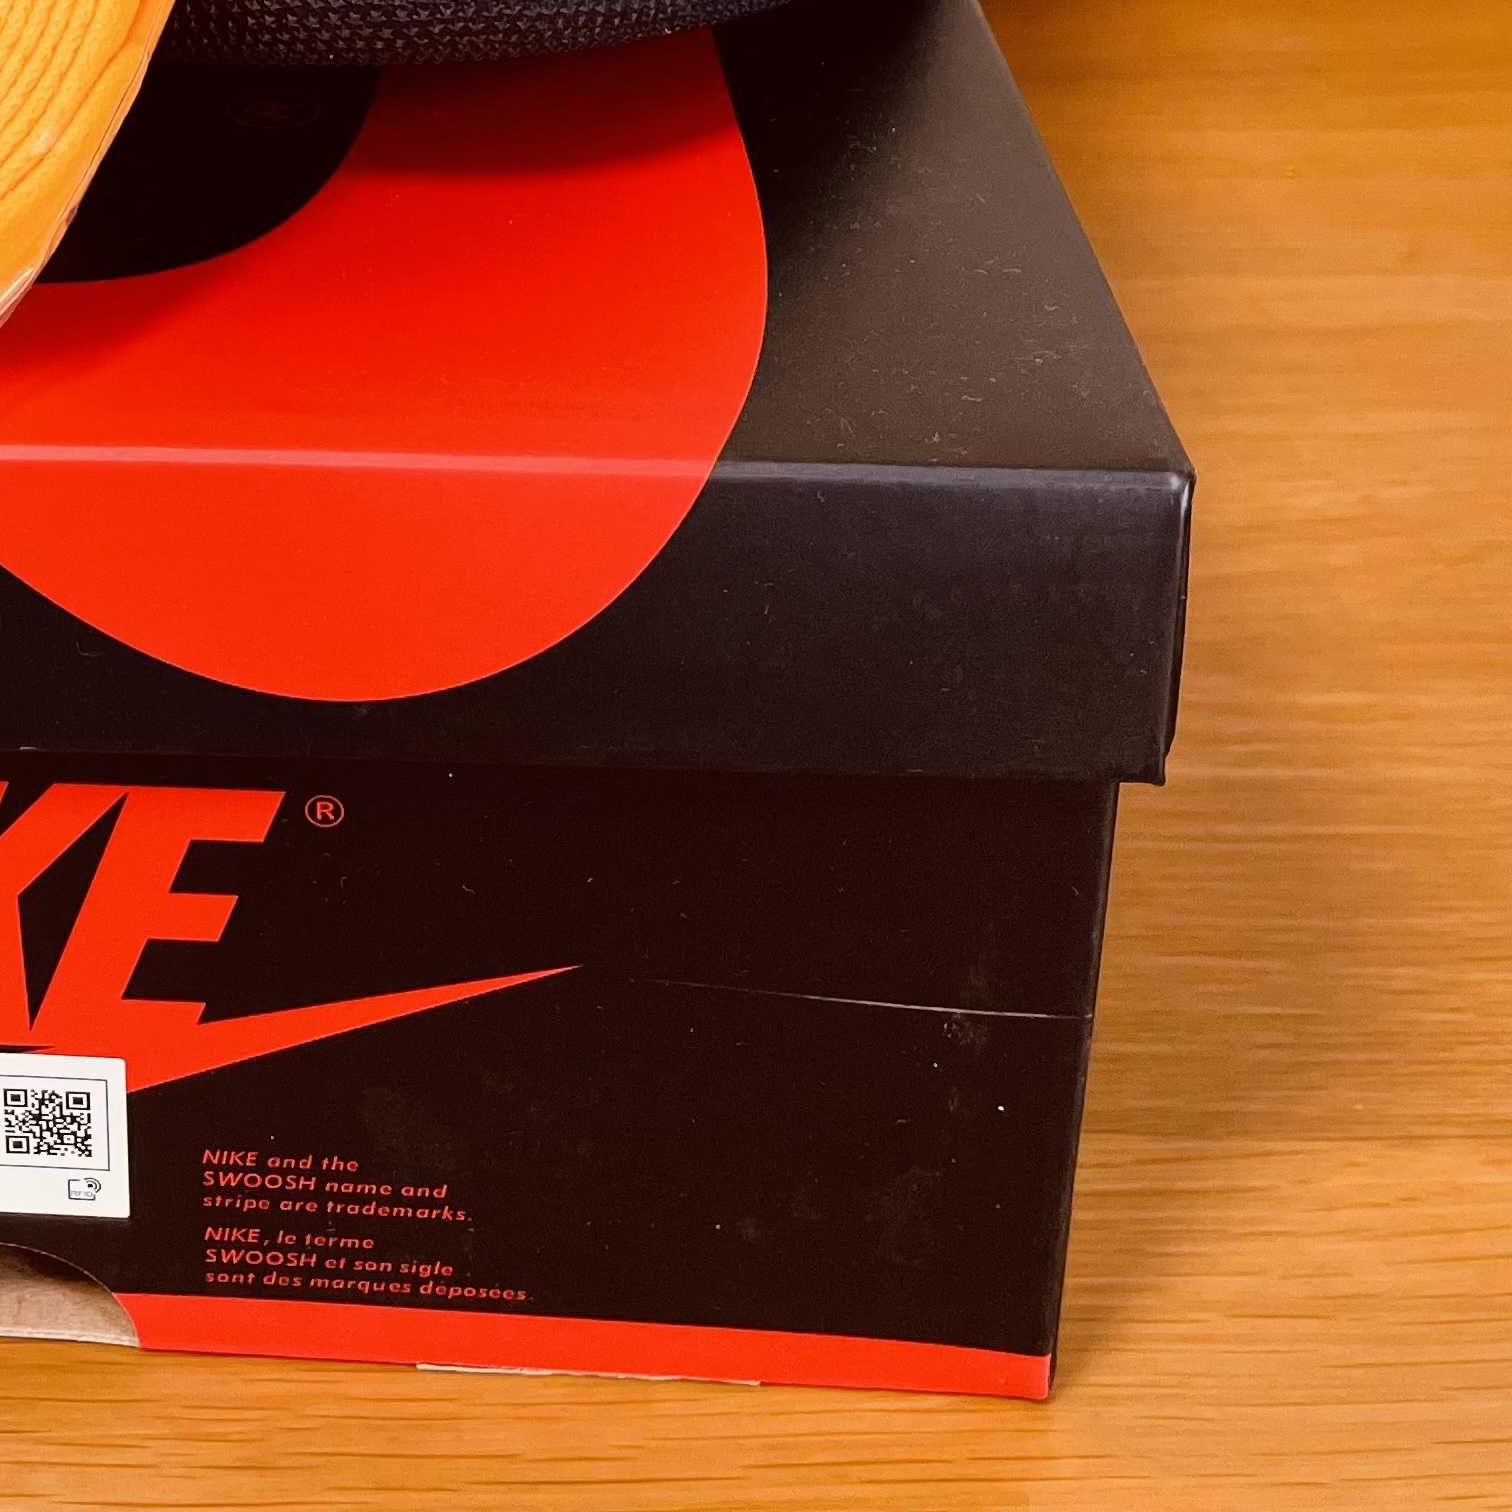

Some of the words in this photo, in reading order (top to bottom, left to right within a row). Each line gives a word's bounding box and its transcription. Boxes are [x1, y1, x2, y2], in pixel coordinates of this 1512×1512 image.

[202, 1149, 259, 1167] NIKE
[267, 1154, 313, 1170] and
[322, 1155, 360, 1172] the
[202, 1170, 317, 1191] SWOOSH
[325, 1182, 393, 1195] name
[400, 1184, 448, 1199] and
[203, 1194, 270, 1212] stripe
[279, 1199, 319, 1213] are
[276, 1230, 297, 1245] le
[304, 1233, 375, 1249] terme
[205, 1248, 318, 1268] SWOOSH
[324, 1257, 346, 1269] et
[353, 1259, 393, 1272] son
[399, 1260, 454, 1278] sigle
[205, 1272, 256, 1285] sont
[263, 1271, 304, 1287] des
[310, 1277, 412, 1294] marques
